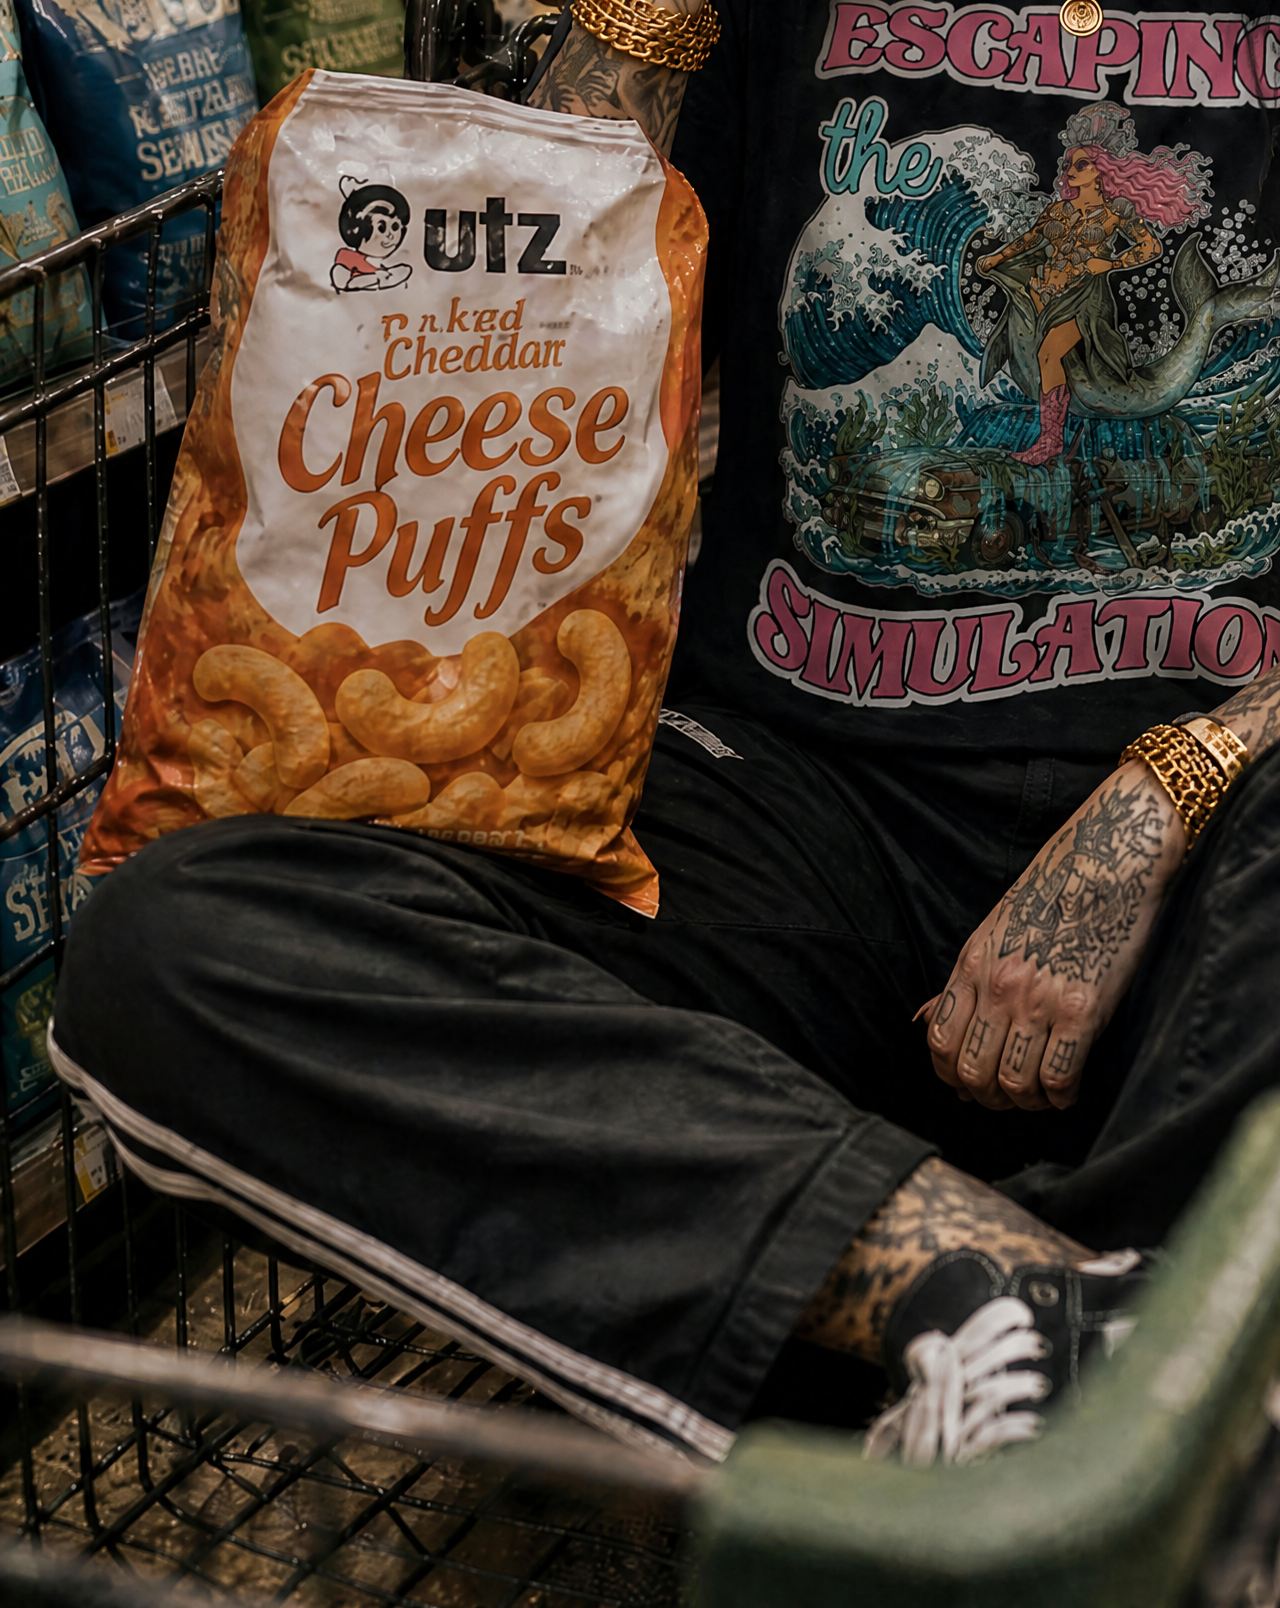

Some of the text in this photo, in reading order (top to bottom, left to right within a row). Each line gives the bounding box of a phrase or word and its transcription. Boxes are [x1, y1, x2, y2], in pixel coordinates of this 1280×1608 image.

[821, 100, 943, 196] the
[423, 196, 567, 275] utz
[278, 371, 629, 493] Cheese
[317, 471, 592, 627] Puffs
